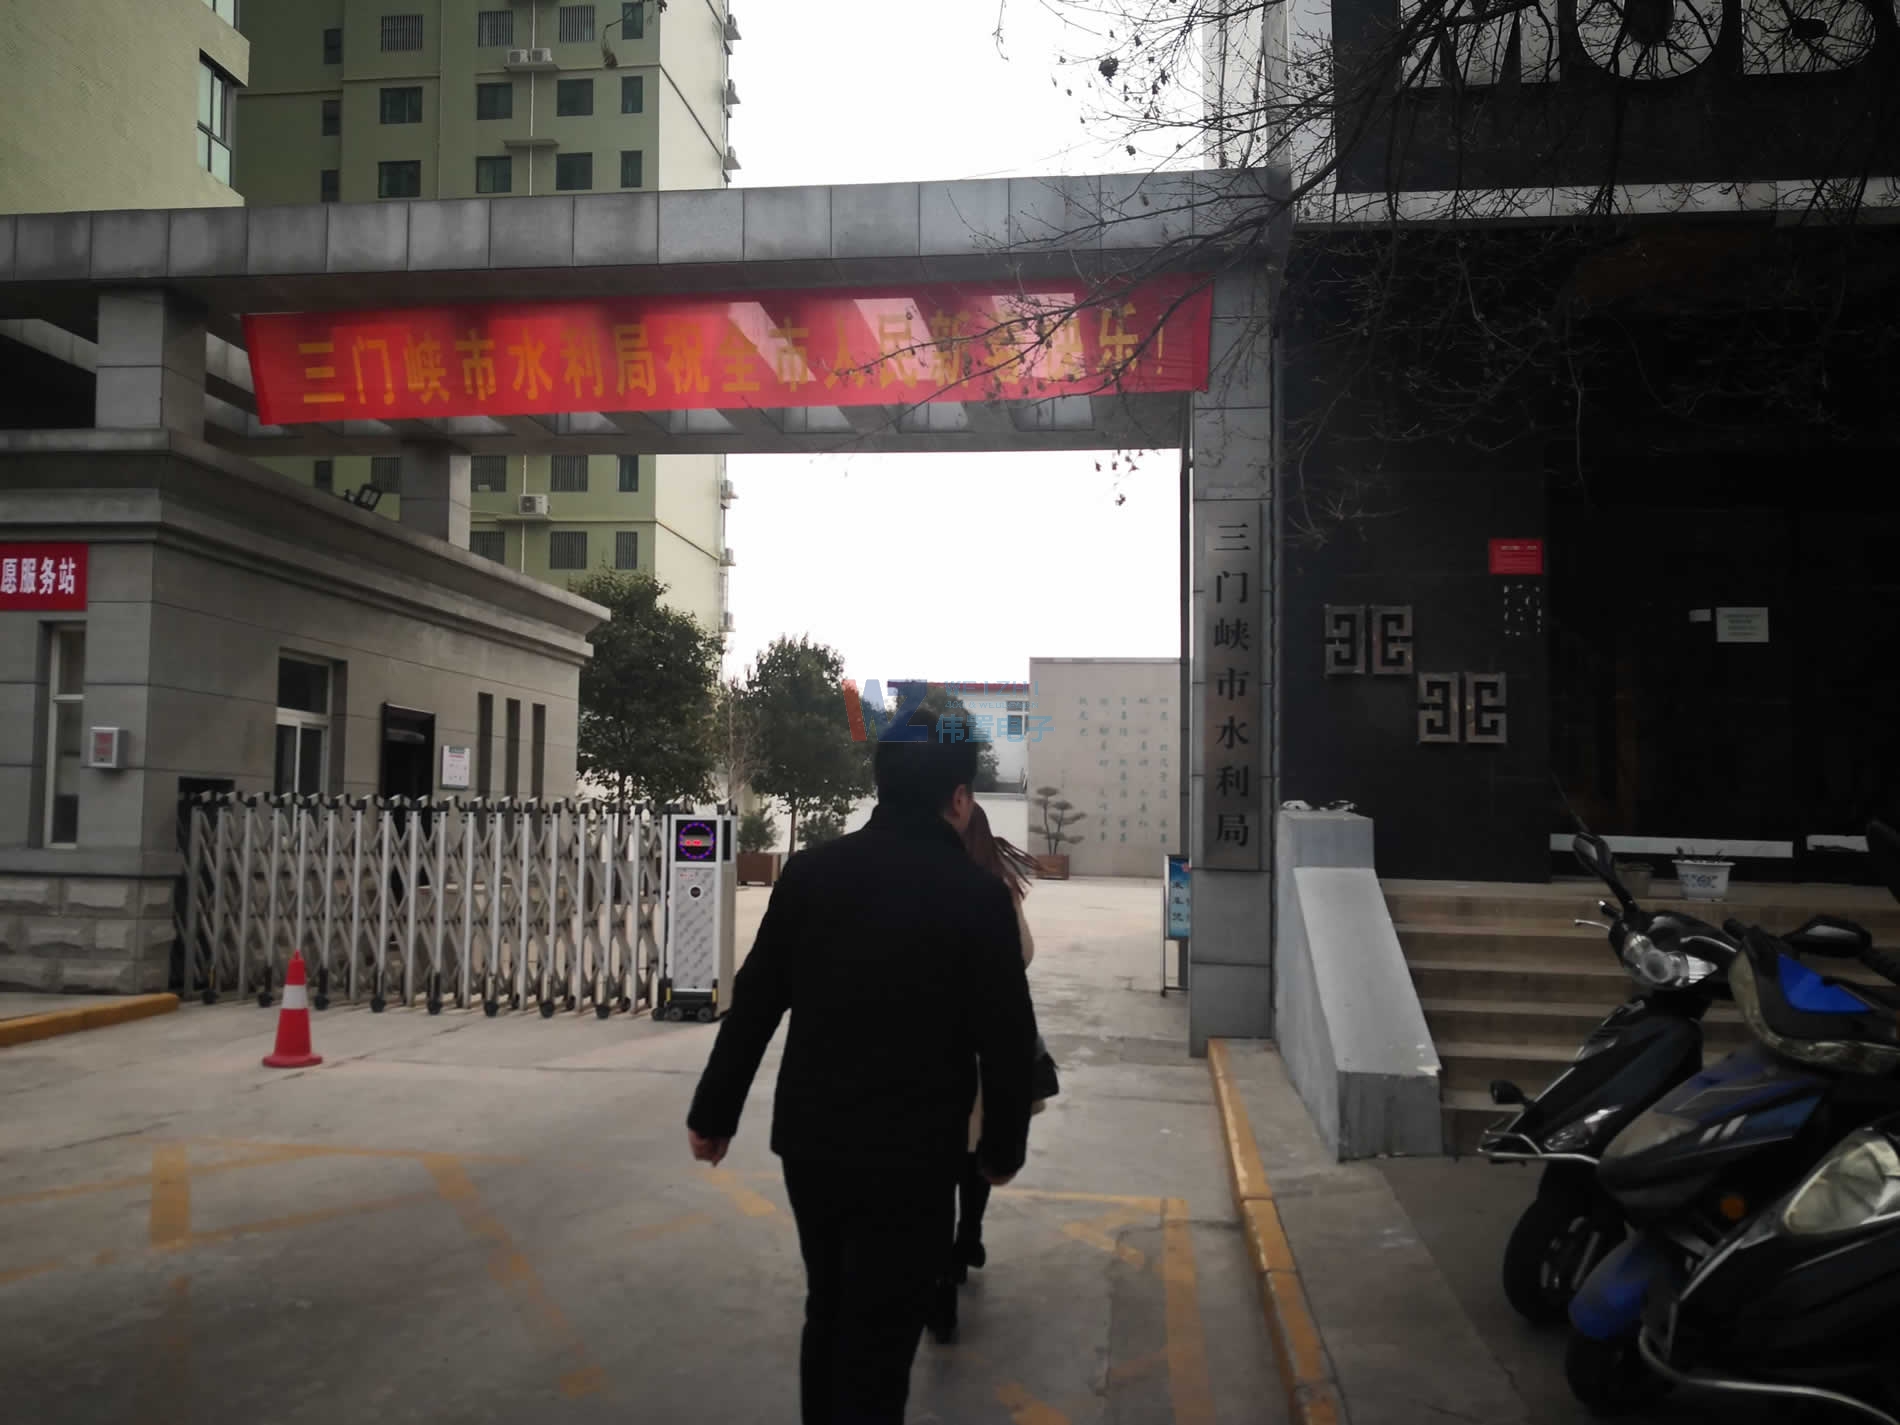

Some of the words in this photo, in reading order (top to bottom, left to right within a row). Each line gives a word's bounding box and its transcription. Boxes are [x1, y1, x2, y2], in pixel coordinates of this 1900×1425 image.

[0, 556, 76, 594] 愿服务站
[1212, 523, 1252, 847] 三门峡市水利局
